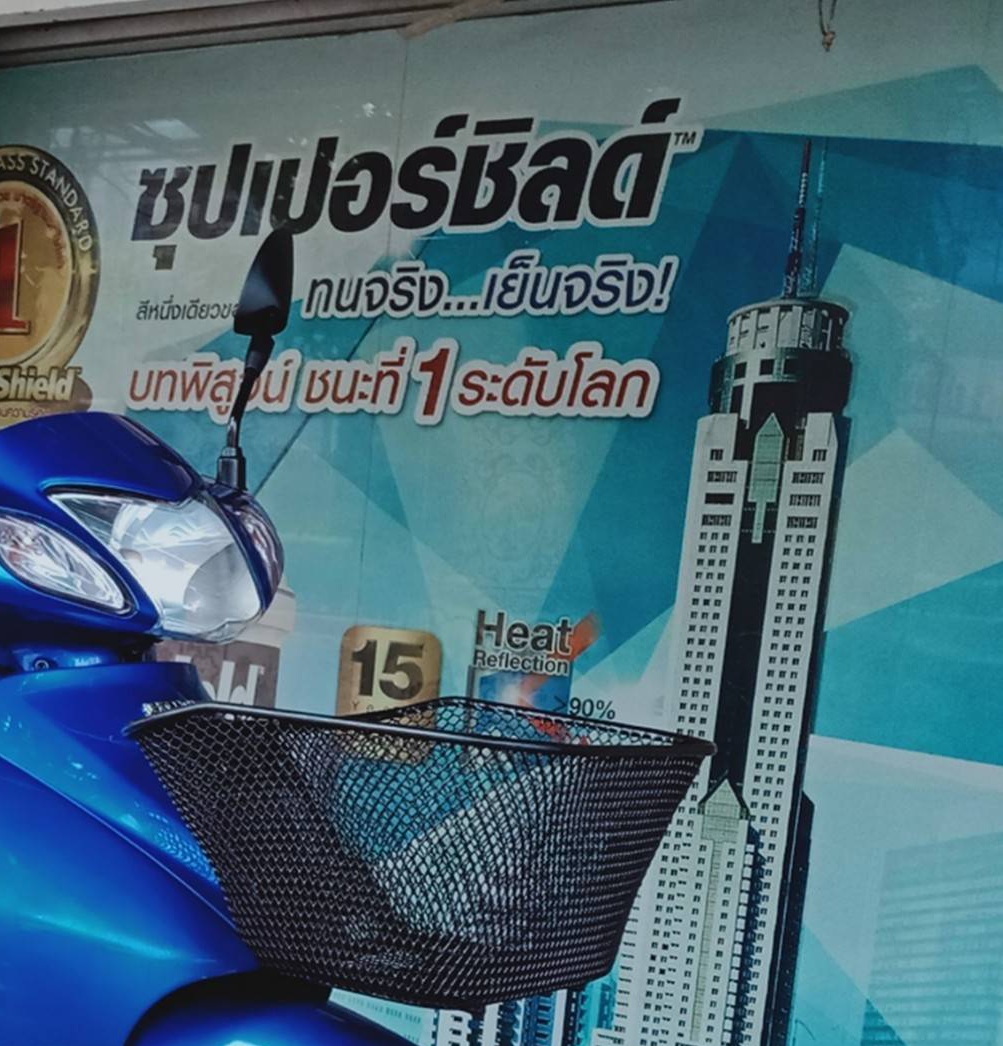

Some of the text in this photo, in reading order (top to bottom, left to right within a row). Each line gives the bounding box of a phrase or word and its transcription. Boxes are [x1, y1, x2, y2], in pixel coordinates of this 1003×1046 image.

[29, 156, 93, 251] STANDARD
[418, 348, 452, 416] 1
[458, 351, 651, 408] ระดับโลก
[473, 649, 569, 676] Reflection
[475, 609, 572, 655] Heat
[351, 639, 424, 700] 15
